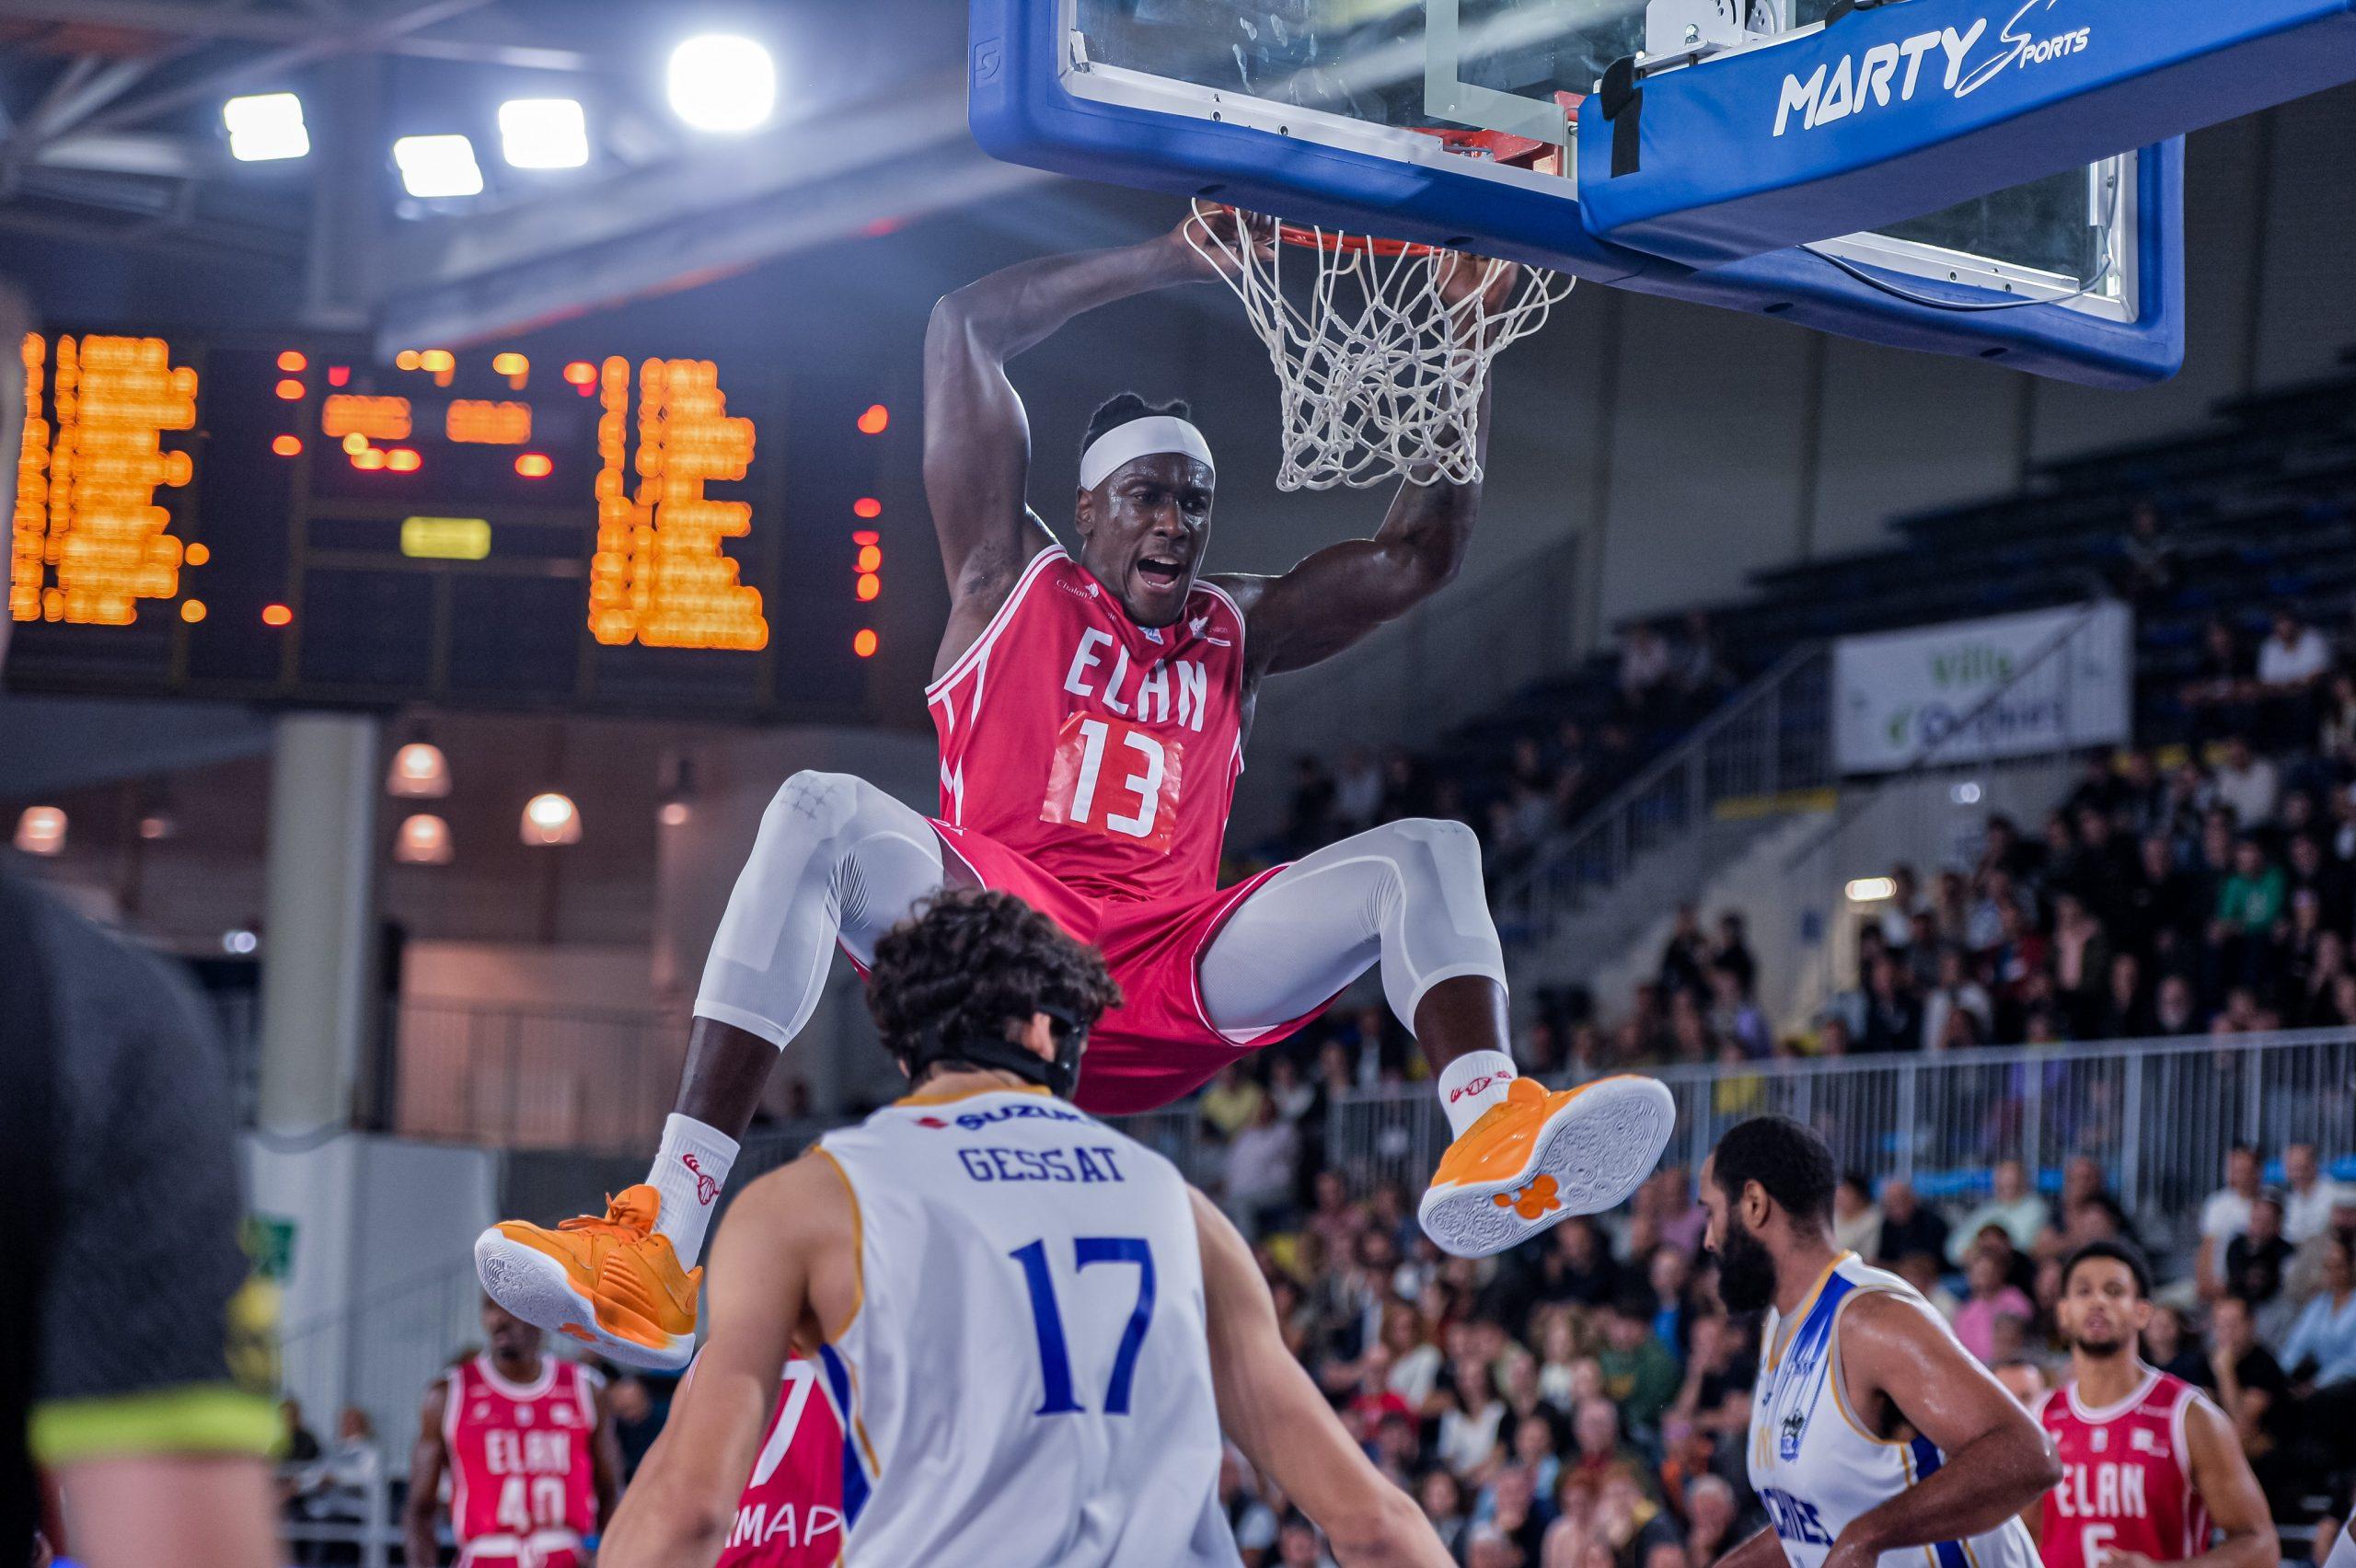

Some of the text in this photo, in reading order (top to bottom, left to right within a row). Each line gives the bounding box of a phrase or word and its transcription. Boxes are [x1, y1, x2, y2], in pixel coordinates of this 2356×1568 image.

[1773, 17, 1988, 137] MARTY
[1063, 626, 1209, 732] ELAN
[1069, 719, 1166, 838] 13
[958, 1147, 1125, 1183] GESSAT
[1008, 1237, 1157, 1415] 17
[2054, 1462, 2148, 1518] ELAN
